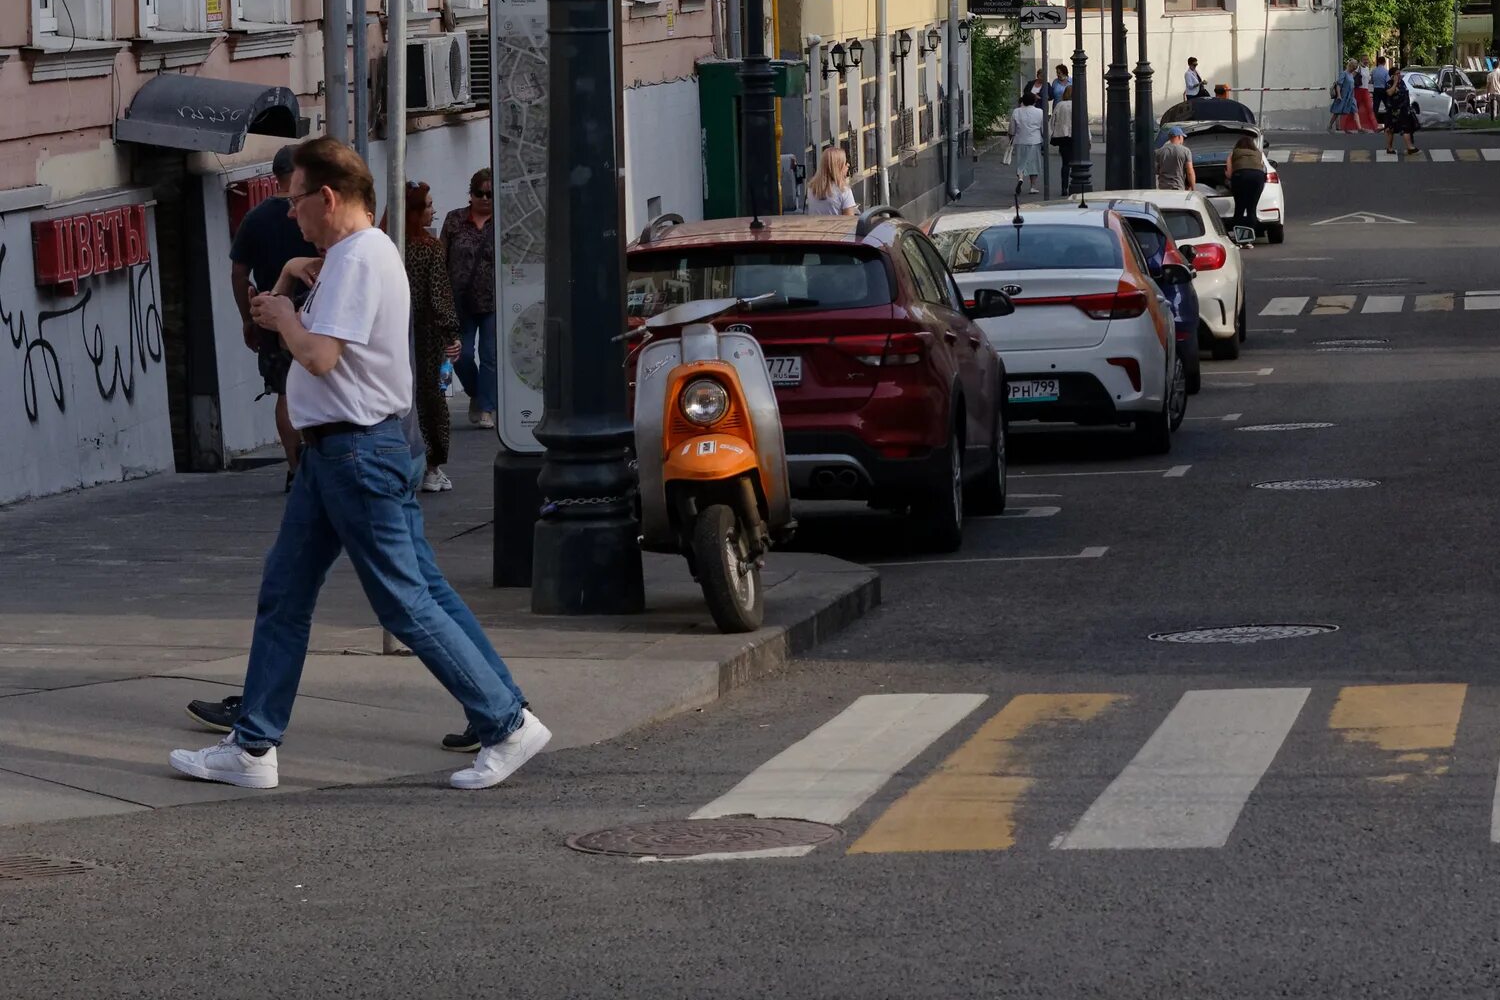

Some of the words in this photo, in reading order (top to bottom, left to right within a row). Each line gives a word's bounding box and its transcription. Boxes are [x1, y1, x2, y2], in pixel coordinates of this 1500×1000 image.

[54, 204, 150, 296] ЦВЕТЫ
[766, 358, 795, 374] 777
[1033, 380, 1055, 392] 799
